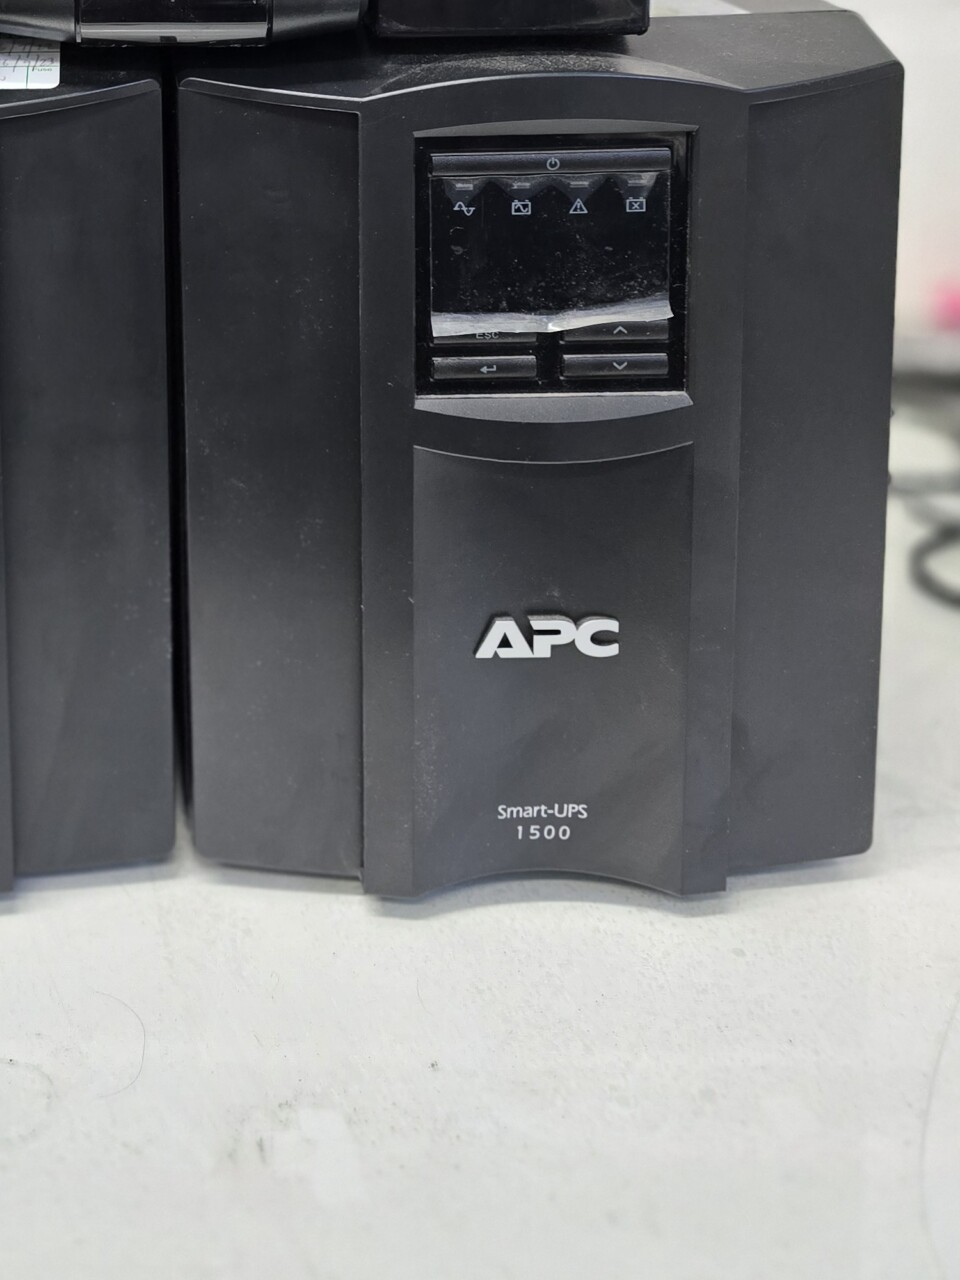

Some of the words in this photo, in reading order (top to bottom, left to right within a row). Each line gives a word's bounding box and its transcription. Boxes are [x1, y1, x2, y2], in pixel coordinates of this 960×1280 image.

[474, 615, 620, 659] APC
[497, 803, 588, 819] Smart-UPS
[517, 825, 571, 840] 1500
